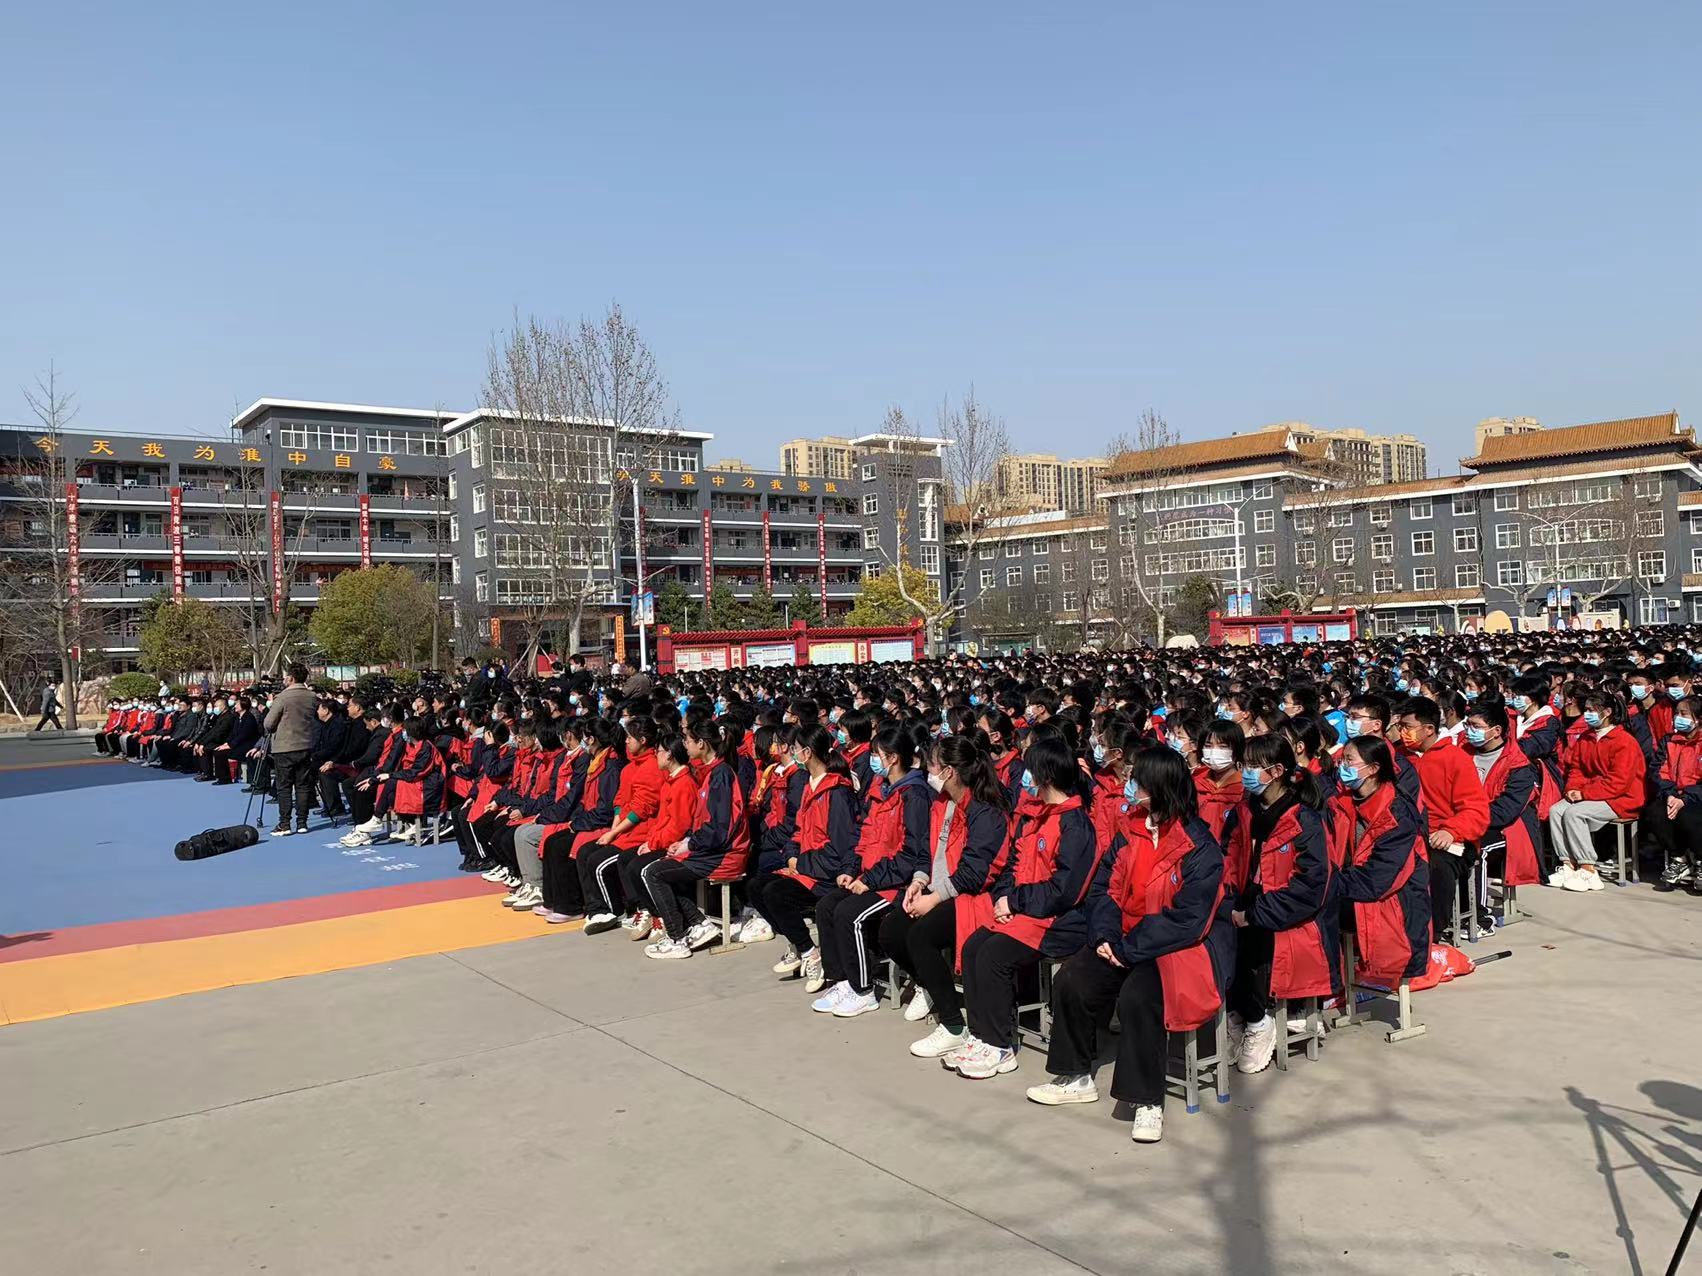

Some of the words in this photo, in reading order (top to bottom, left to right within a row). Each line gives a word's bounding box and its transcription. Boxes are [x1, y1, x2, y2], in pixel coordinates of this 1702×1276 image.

[36, 437, 398, 470] 今天我为淮中自豪
